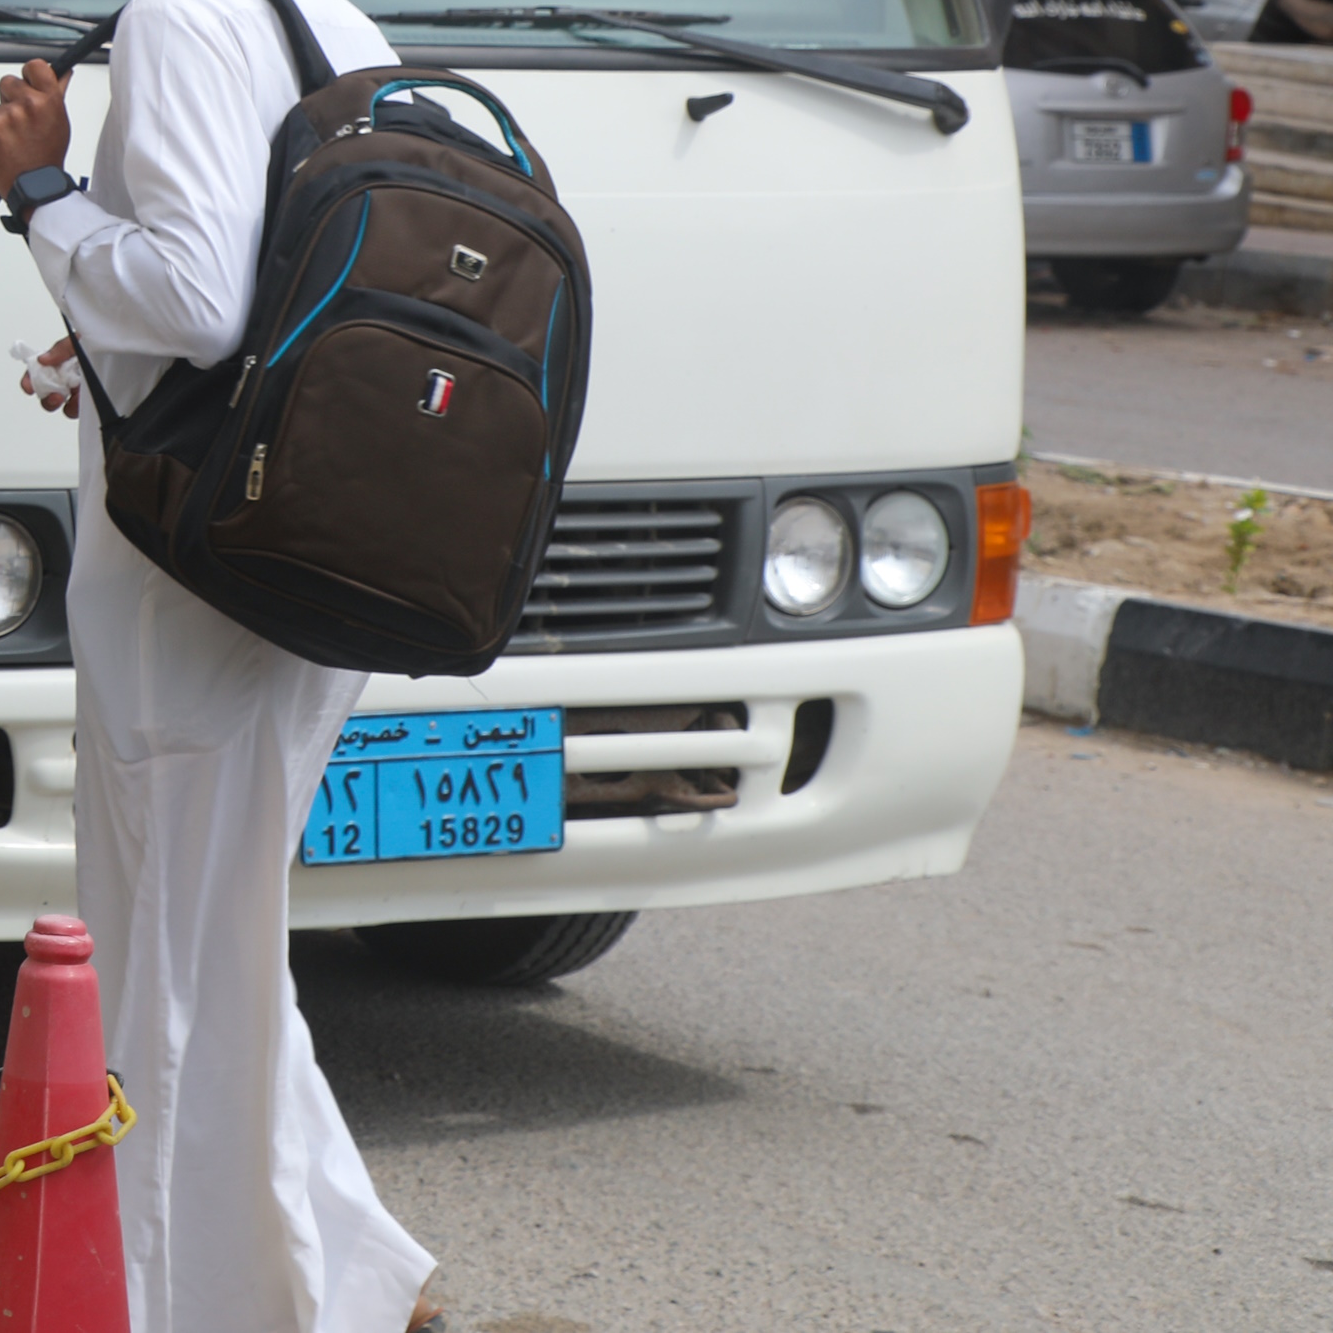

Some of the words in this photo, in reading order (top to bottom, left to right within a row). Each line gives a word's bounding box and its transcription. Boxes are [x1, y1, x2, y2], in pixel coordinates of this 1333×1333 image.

[463, 714, 536, 750] اليمن
[414, 759, 529, 810] ١٥٨٢٩
[322, 822, 362, 856] 12
[420, 813, 525, 851] 15829
